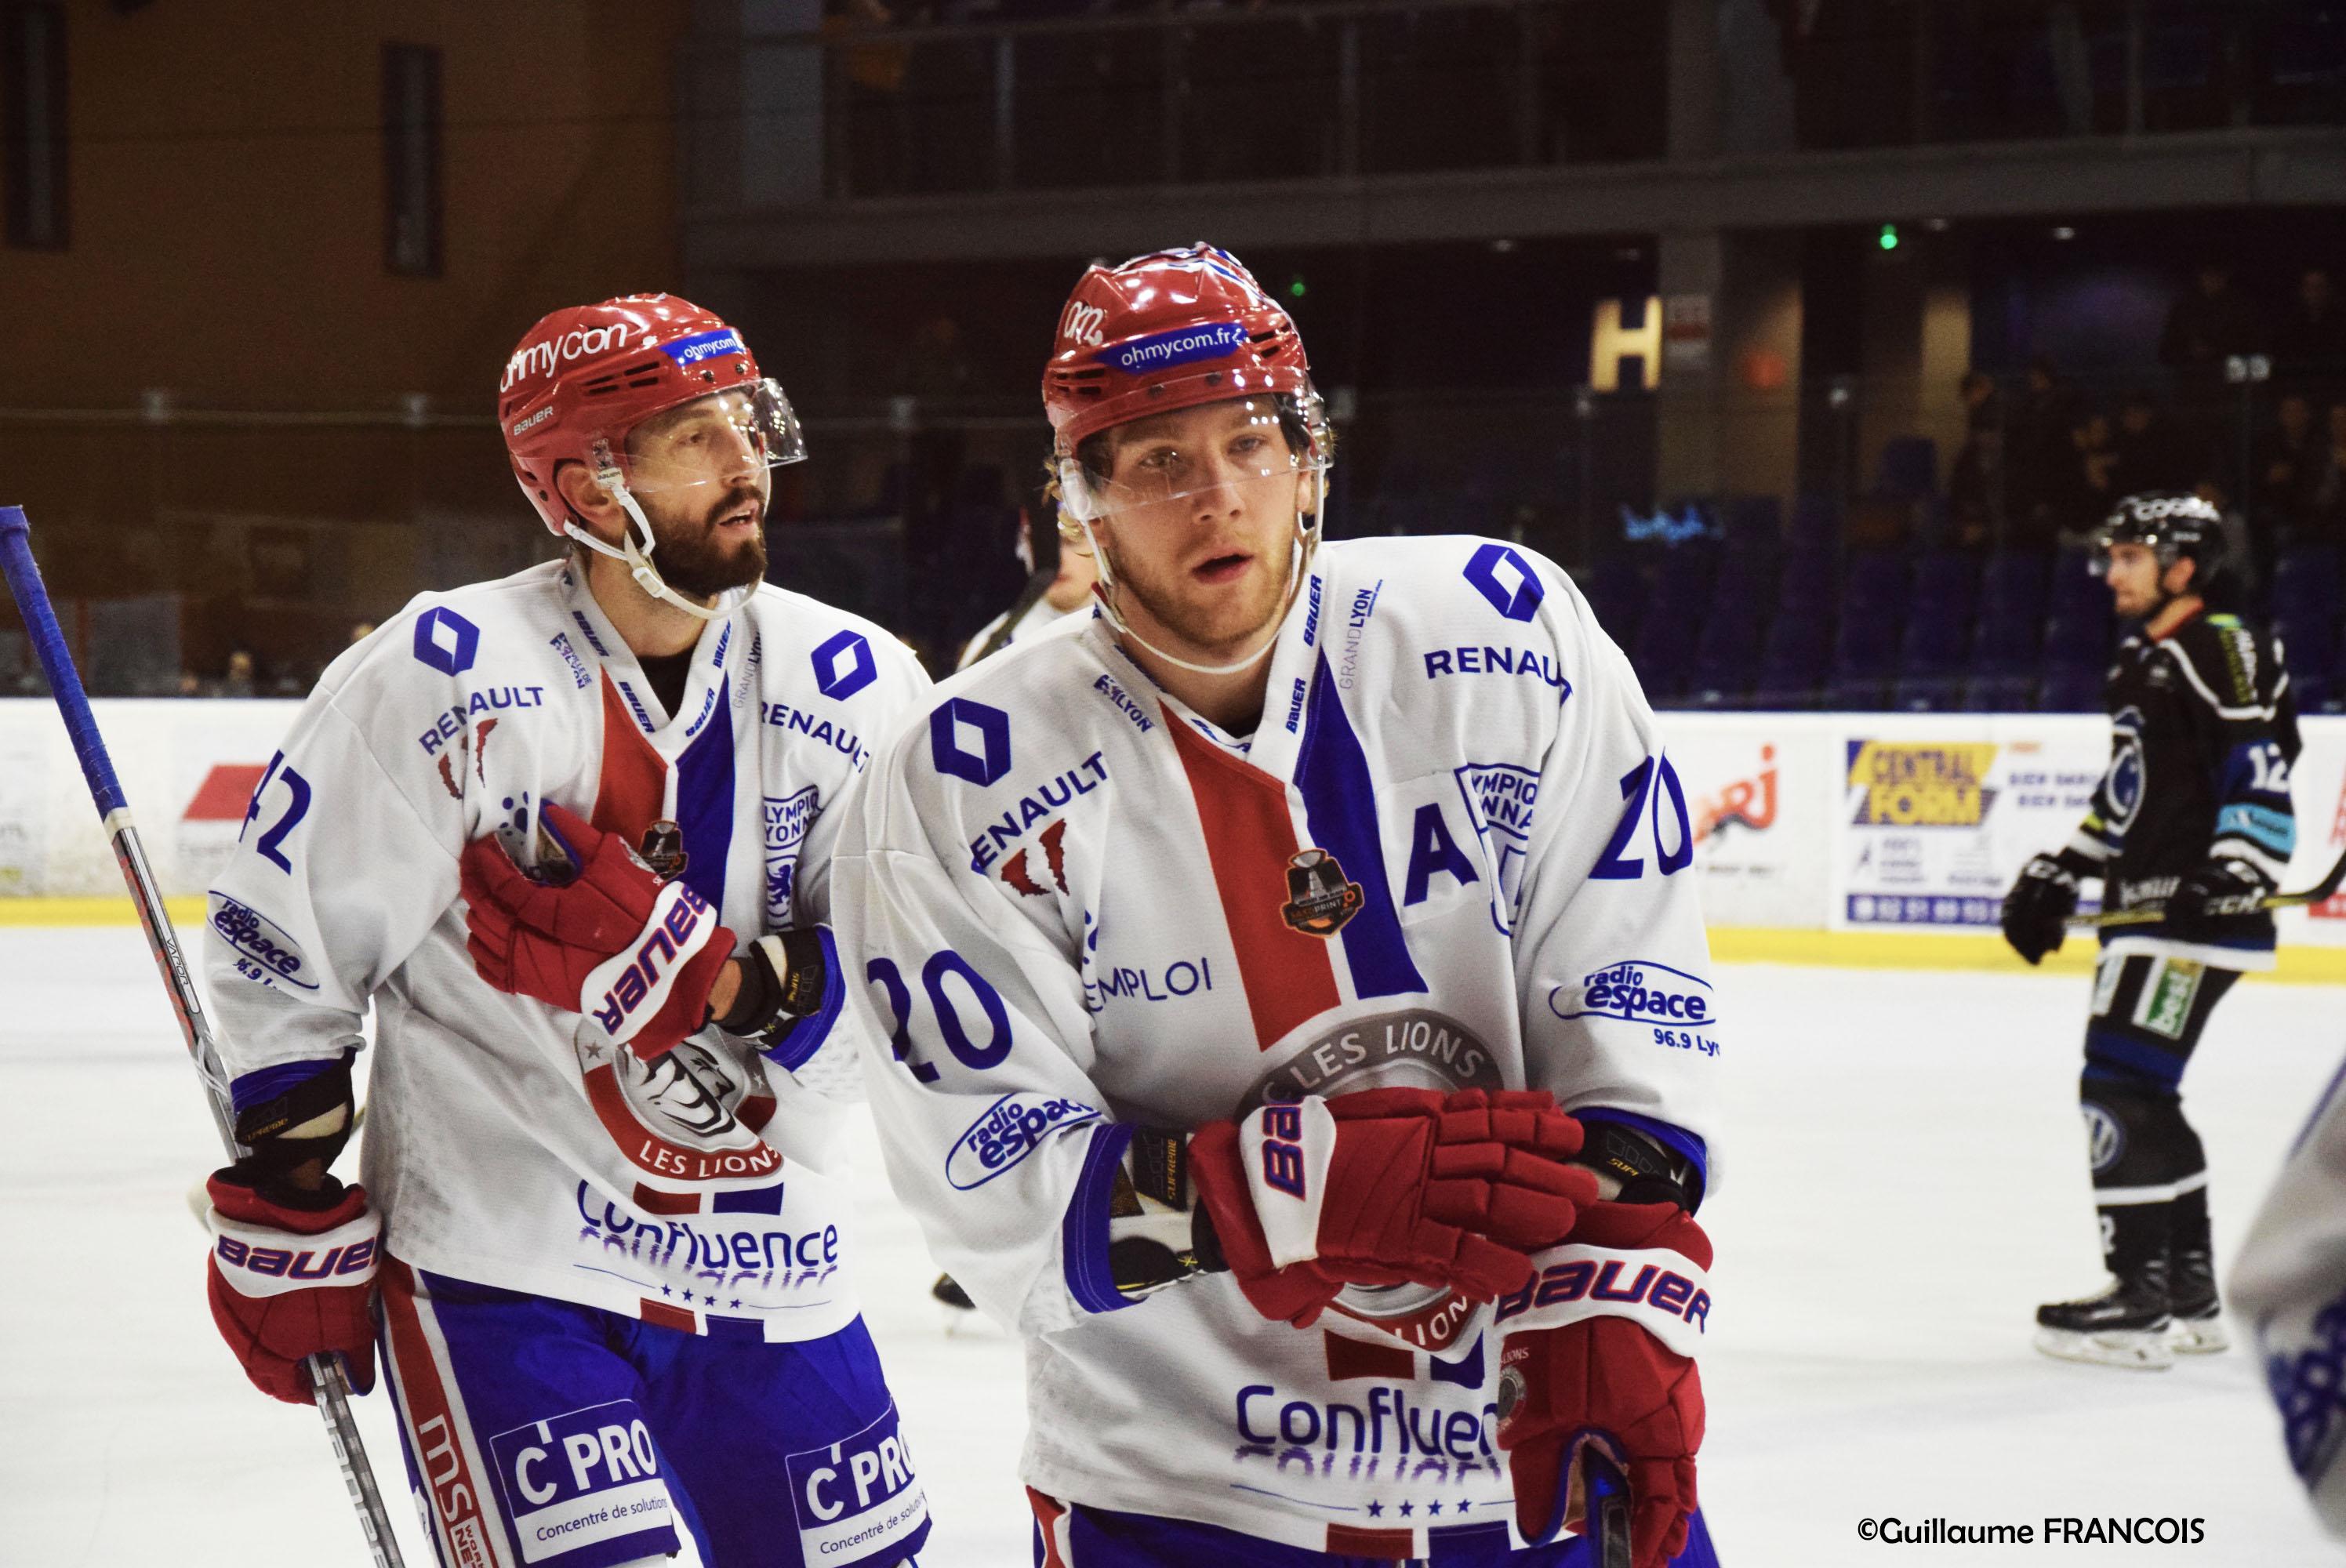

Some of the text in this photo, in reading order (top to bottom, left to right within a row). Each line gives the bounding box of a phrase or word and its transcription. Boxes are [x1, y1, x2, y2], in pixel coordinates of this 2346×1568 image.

[1121, 327, 1232, 366] ohmycom.fr
[1590, 296, 1663, 393] H
[419, 686, 543, 757] RENAULT
[764, 790, 819, 824] LYMPIQ
[1472, 772, 1539, 806] YMPIQ
[1588, 750, 1694, 880] 20
[1404, 802, 1480, 908] A
[214, 910, 301, 975] espace
[1584, 965, 1644, 989] radio
[866, 949, 1014, 1083] 20
[1584, 983, 1707, 1019] espace
[1290, 1021, 1485, 1090] LES LIONS
[1654, 1028, 1692, 1049] 96.9
[967, 1103, 1023, 1152] radio
[639, 1139, 780, 1178] LES LIONS
[216, 1233, 380, 1280] BAUE
[1396, 1296, 1469, 1346] ION
[536, 1506, 609, 1541] Concentré
[612, 1504, 628, 1519] de
[819, 1520, 884, 1555] Concentré
[886, 1515, 899, 1530] de
